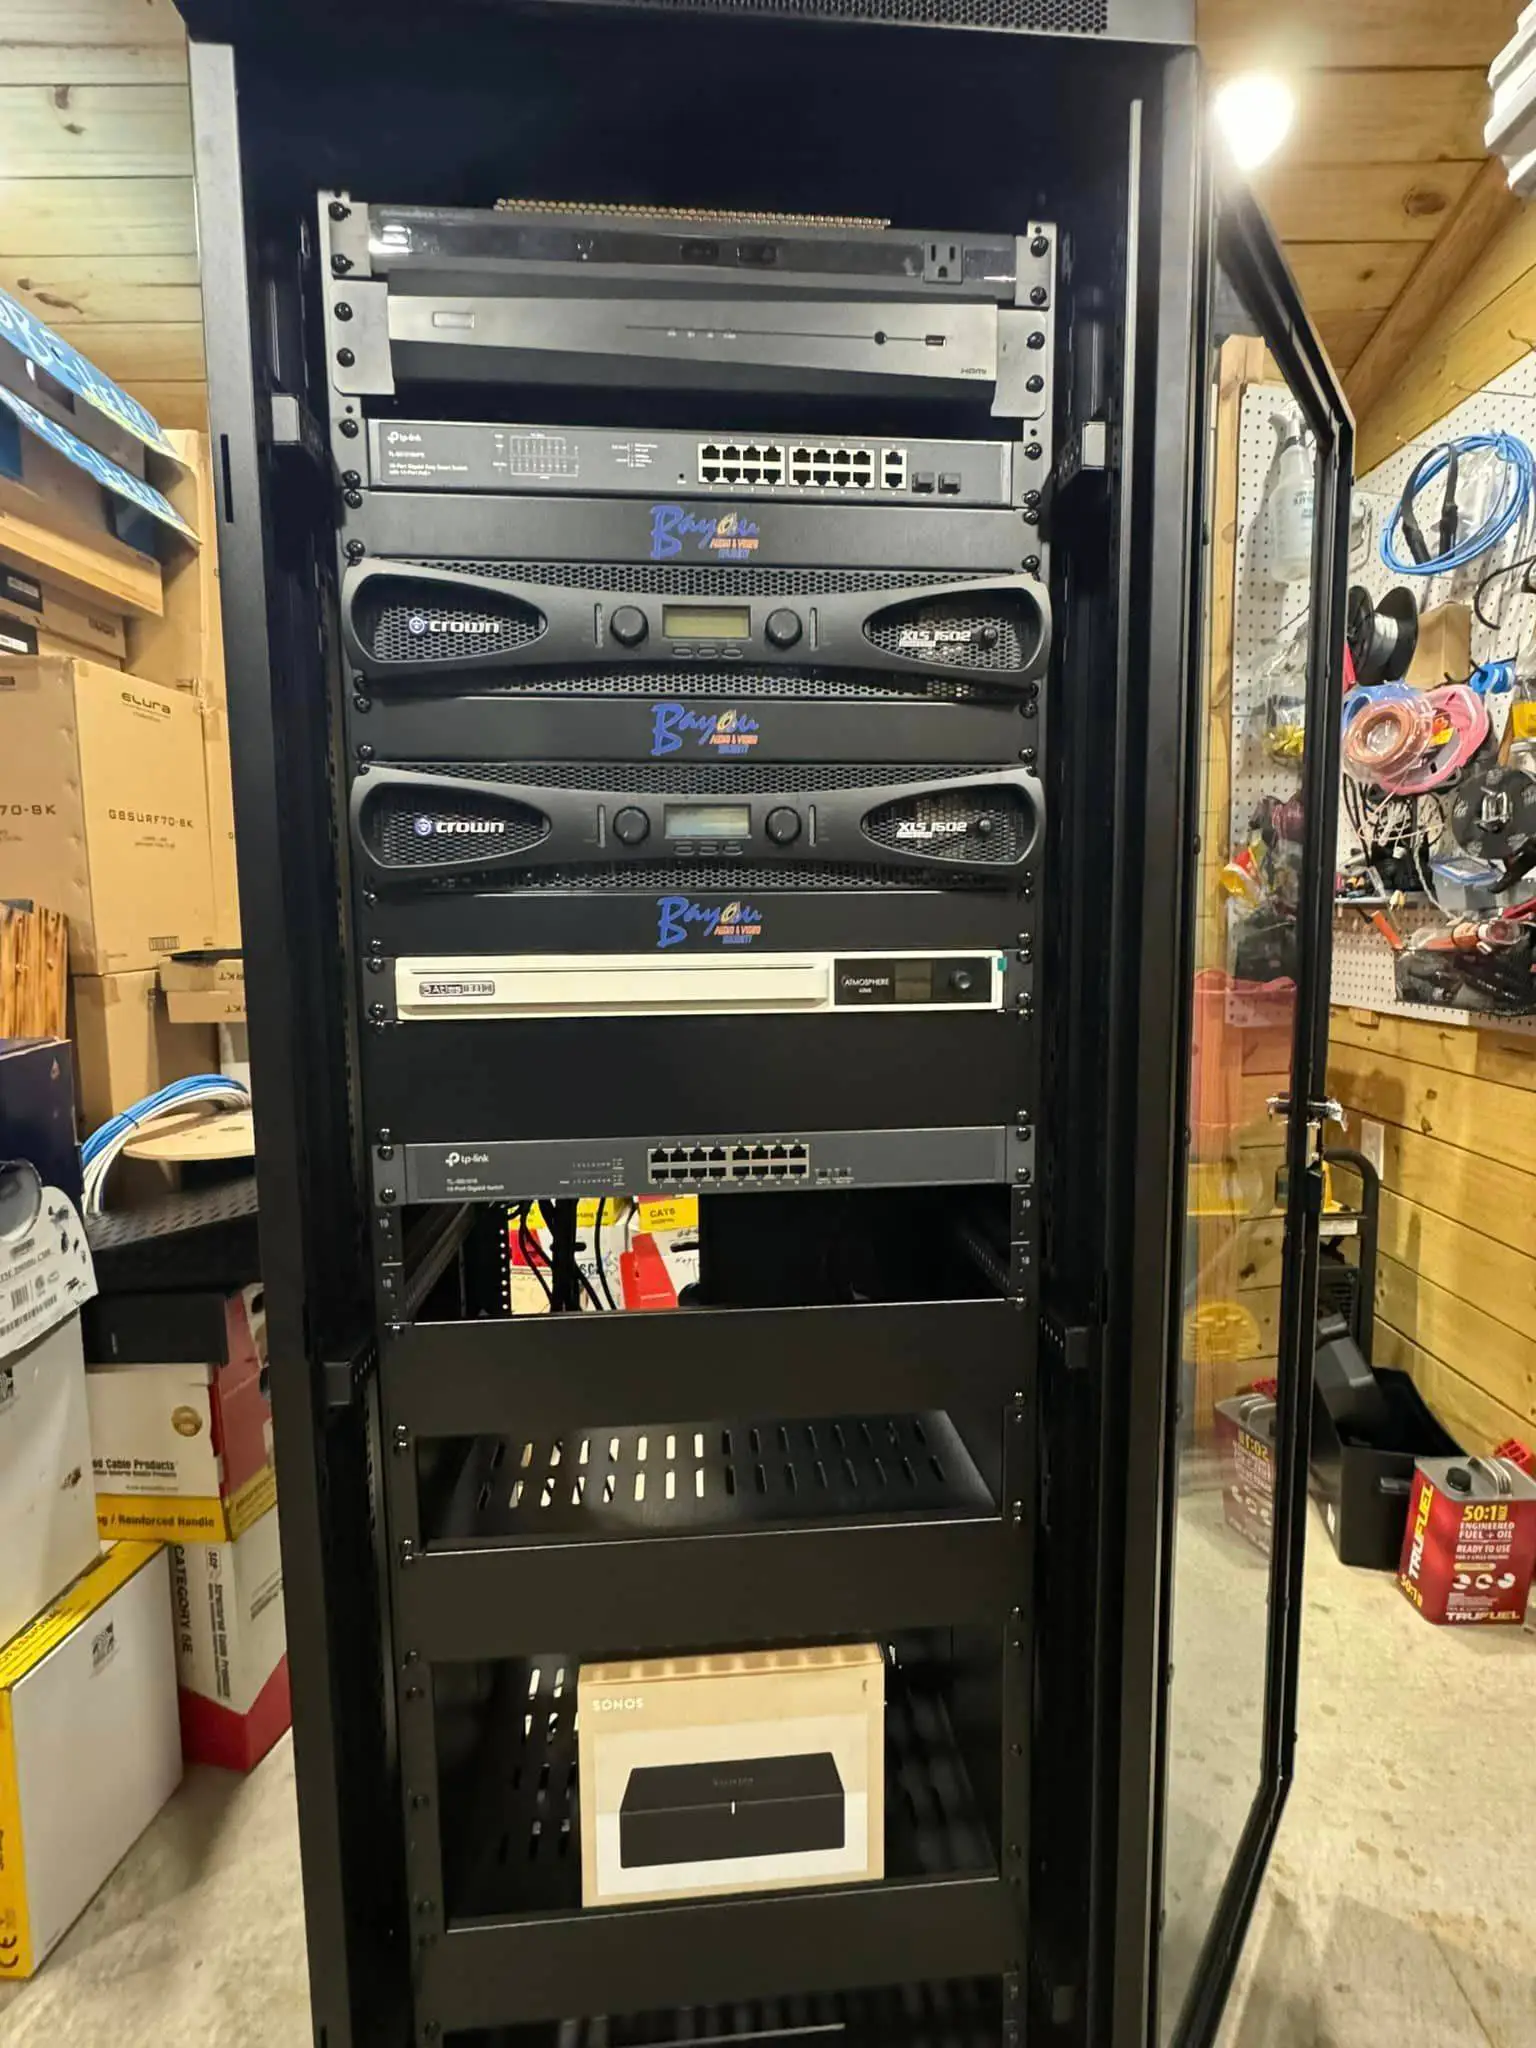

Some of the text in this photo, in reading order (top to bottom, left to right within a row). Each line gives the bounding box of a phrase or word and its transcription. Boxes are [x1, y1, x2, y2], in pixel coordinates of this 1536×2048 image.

[650, 504, 760, 559] Bayou
[429, 620, 499, 634] crown
[651, 703, 759, 755] Bayou
[435, 821, 504, 833] crown
[656, 895, 762, 948] Bayou
[713, 925, 735, 936] AUDIO
[741, 925, 761, 936] VIDEO
[845, 977, 889, 987] ATMOSPHERE
[461, 1154, 489, 1165] tp-link
[106, 1459, 131, 1470] Cable
[134, 1460, 175, 1471] Products
[1462, 1505, 1498, 1521] 50:1
[119, 1515, 174, 1527] Reinforced
[178, 1517, 214, 1528] Handle
[1460, 1521, 1515, 1531] ENGINEERED
[1408, 1483, 1434, 1580] TRUFUEL
[1459, 1530, 1484, 1539] FUEL
[1496, 1530, 1513, 1538] OIL
[1456, 1544, 1511, 1553] READY TO USE
[174, 1544, 191, 1629] CATEGORY
[1445, 1610, 1520, 1621] TRUFUEL
[592, 1697, 645, 1711] SONOS
